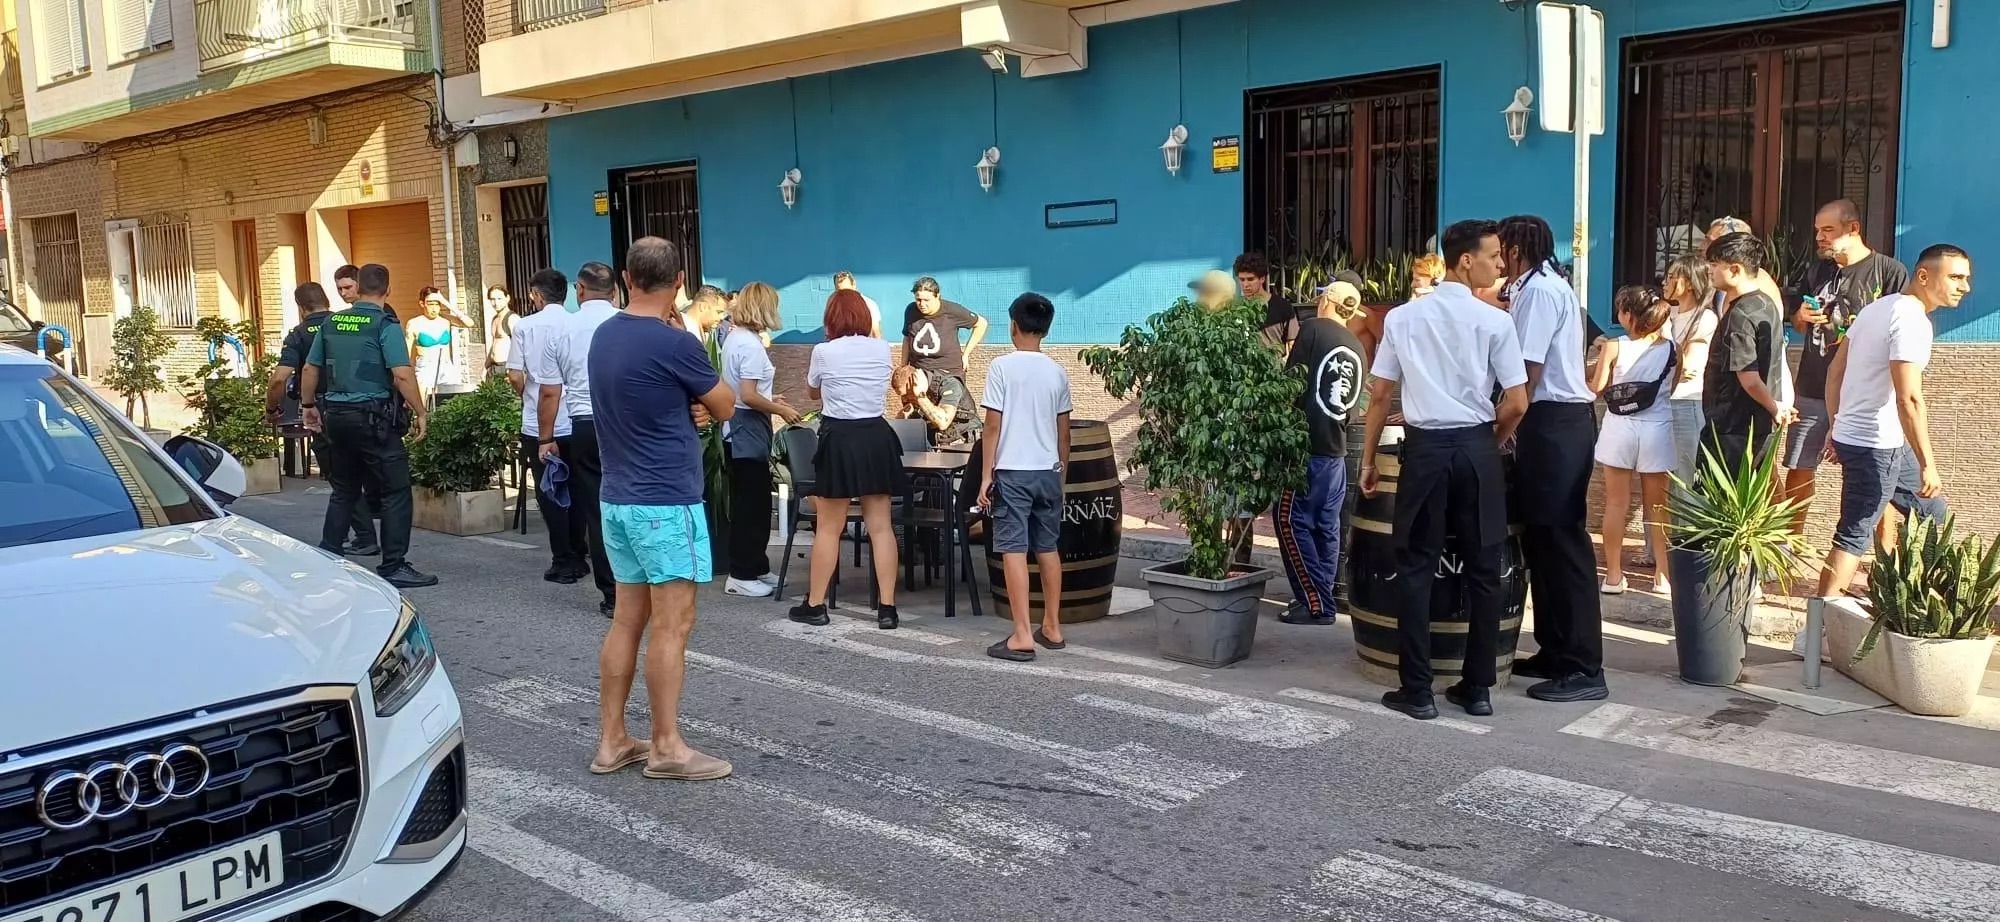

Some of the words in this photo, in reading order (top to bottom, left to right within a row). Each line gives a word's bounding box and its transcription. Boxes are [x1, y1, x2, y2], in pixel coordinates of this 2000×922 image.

[331, 314, 371, 324] GUARDIA
[336, 323, 360, 332] CIVIL
[1060, 496, 1119, 525] RNÁIZ
[179, 843, 271, 912] LPM
